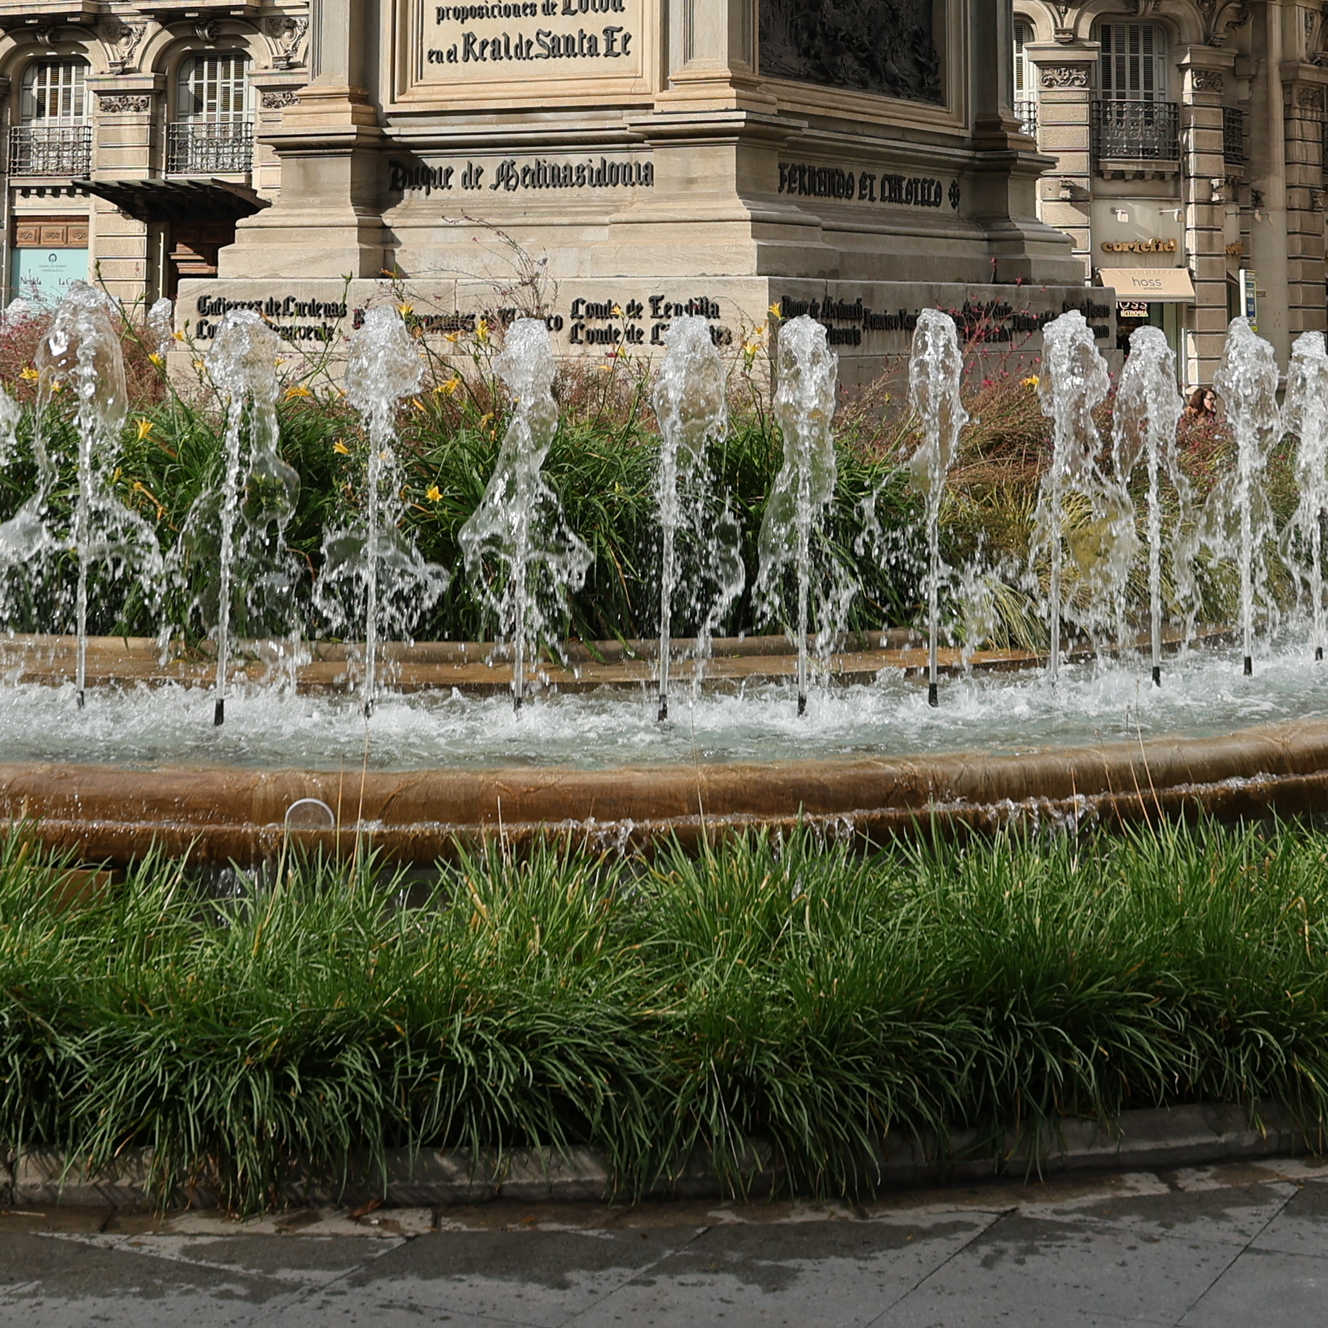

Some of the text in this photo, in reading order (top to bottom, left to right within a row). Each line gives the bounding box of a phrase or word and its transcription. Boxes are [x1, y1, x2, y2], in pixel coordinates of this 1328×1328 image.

[435, 0, 537, 25] proposiciones
[427, 25, 633, 65] en el Real de Santa Fe
[388, 156, 655, 196] Duque de Medinasidonia
[1131, 276, 1162, 287] hoss
[265, 296, 281, 317] de
[626, 298, 644, 319] de
[569, 321, 621, 345] Conde
[626, 323, 644, 345] de
